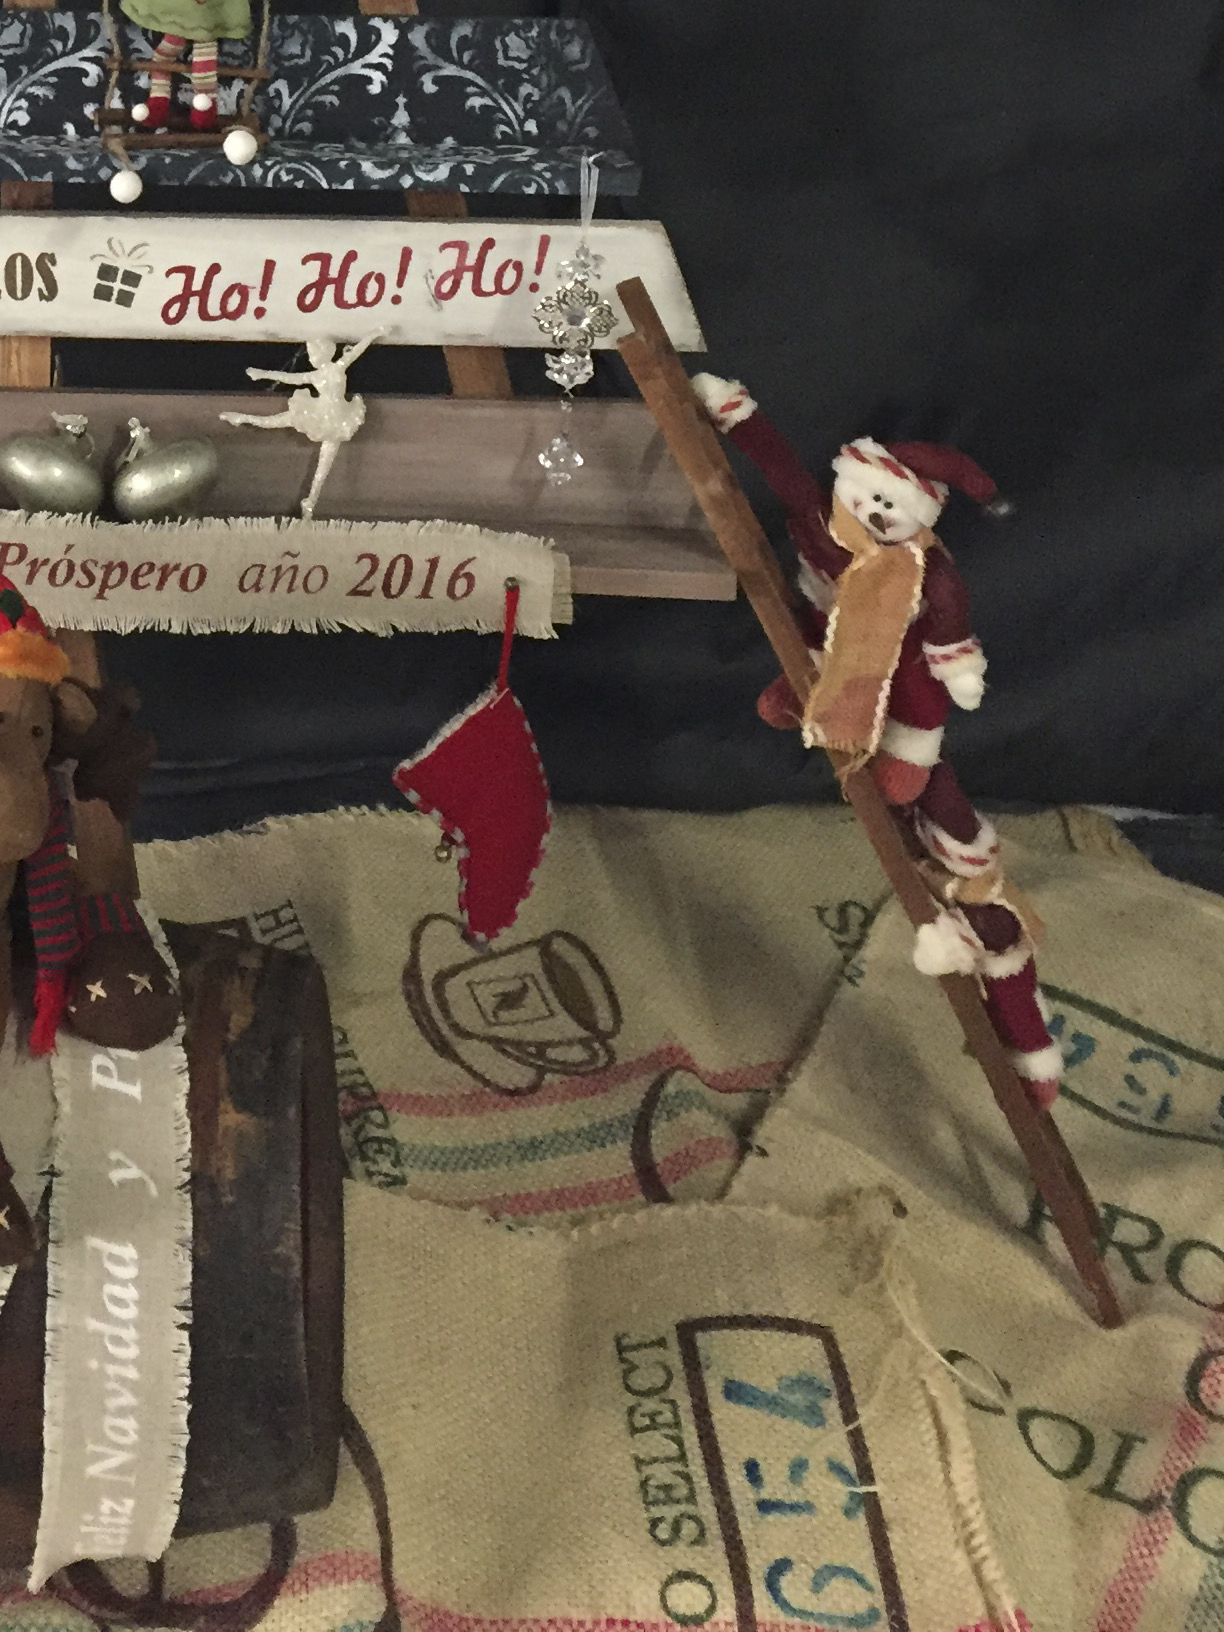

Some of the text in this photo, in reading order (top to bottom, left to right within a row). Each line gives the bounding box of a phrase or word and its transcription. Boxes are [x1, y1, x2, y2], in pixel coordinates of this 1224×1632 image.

[160, 234, 551, 326] Ho! Ho! Ho!
[237, 550, 329, 596] año
[345, 552, 477, 602] 2016
[108, 1150, 160, 1199] y
[85, 1233, 142, 1486] Navidad
[615, 1331, 707, 1549] SELECT
